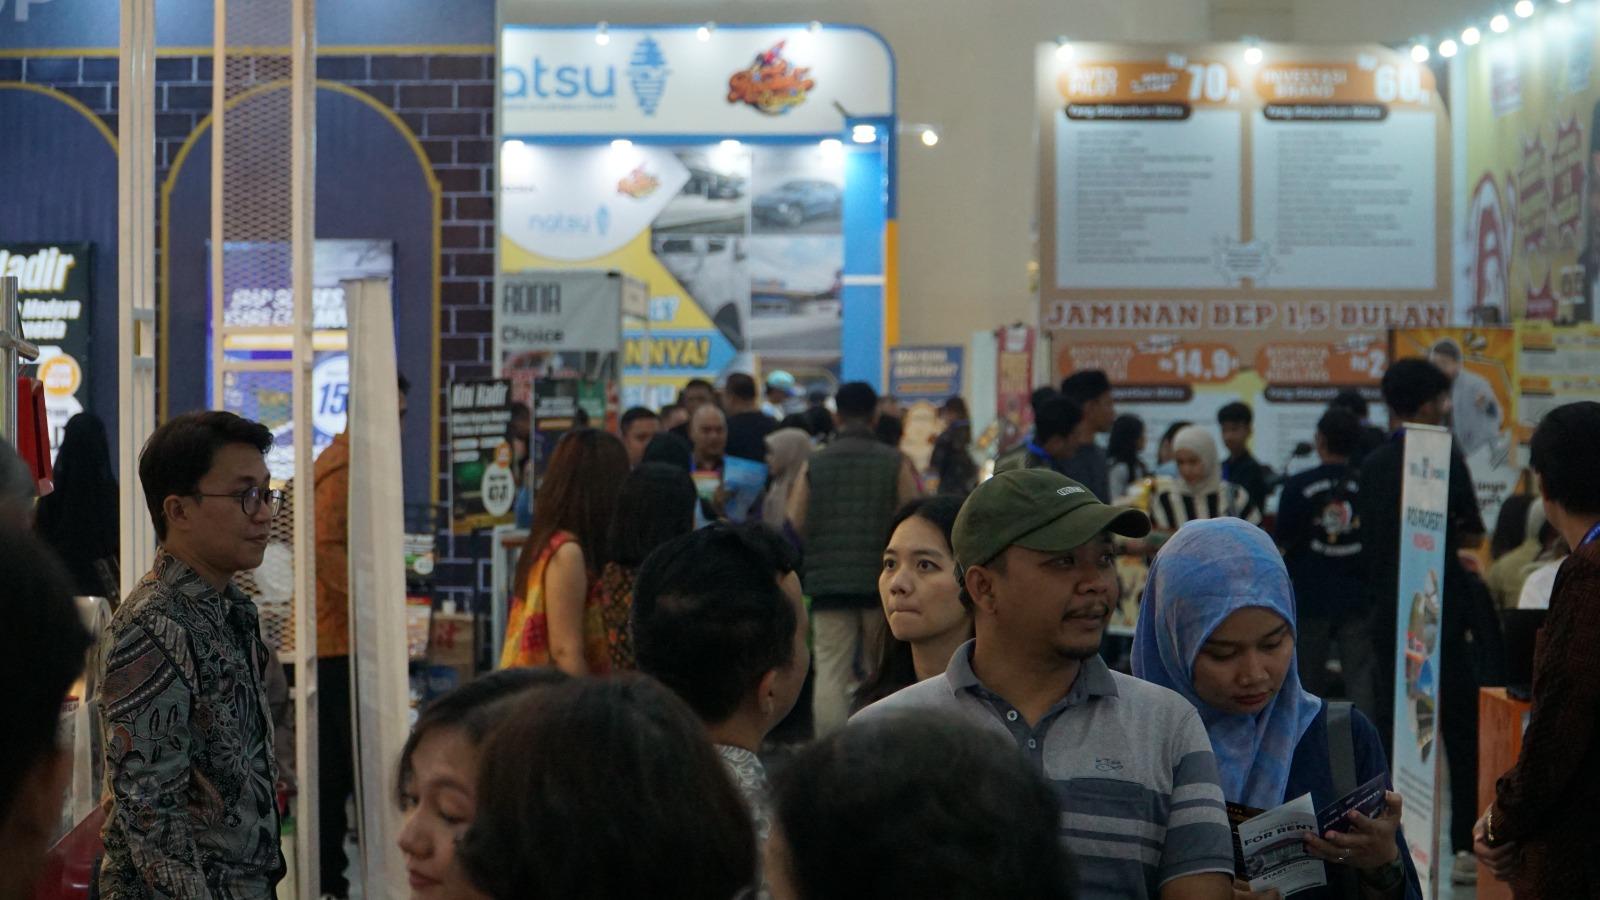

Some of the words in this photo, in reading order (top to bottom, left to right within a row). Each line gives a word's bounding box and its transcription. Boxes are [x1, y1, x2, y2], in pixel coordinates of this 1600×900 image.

[502, 57, 616, 98] atsu
[1263, 70, 1347, 83] INVESTASI
[1275, 84, 1335, 97] BRAND
[1047, 303, 1200, 327] JAMINAN
[1212, 303, 1273, 326] BEP
[1339, 303, 1448, 328] BULAN
[503, 326, 564, 345] Choice
[622, 337, 711, 369] NNYA!
[1244, 831, 1273, 846] FOR
[1277, 824, 1314, 835] RENT
